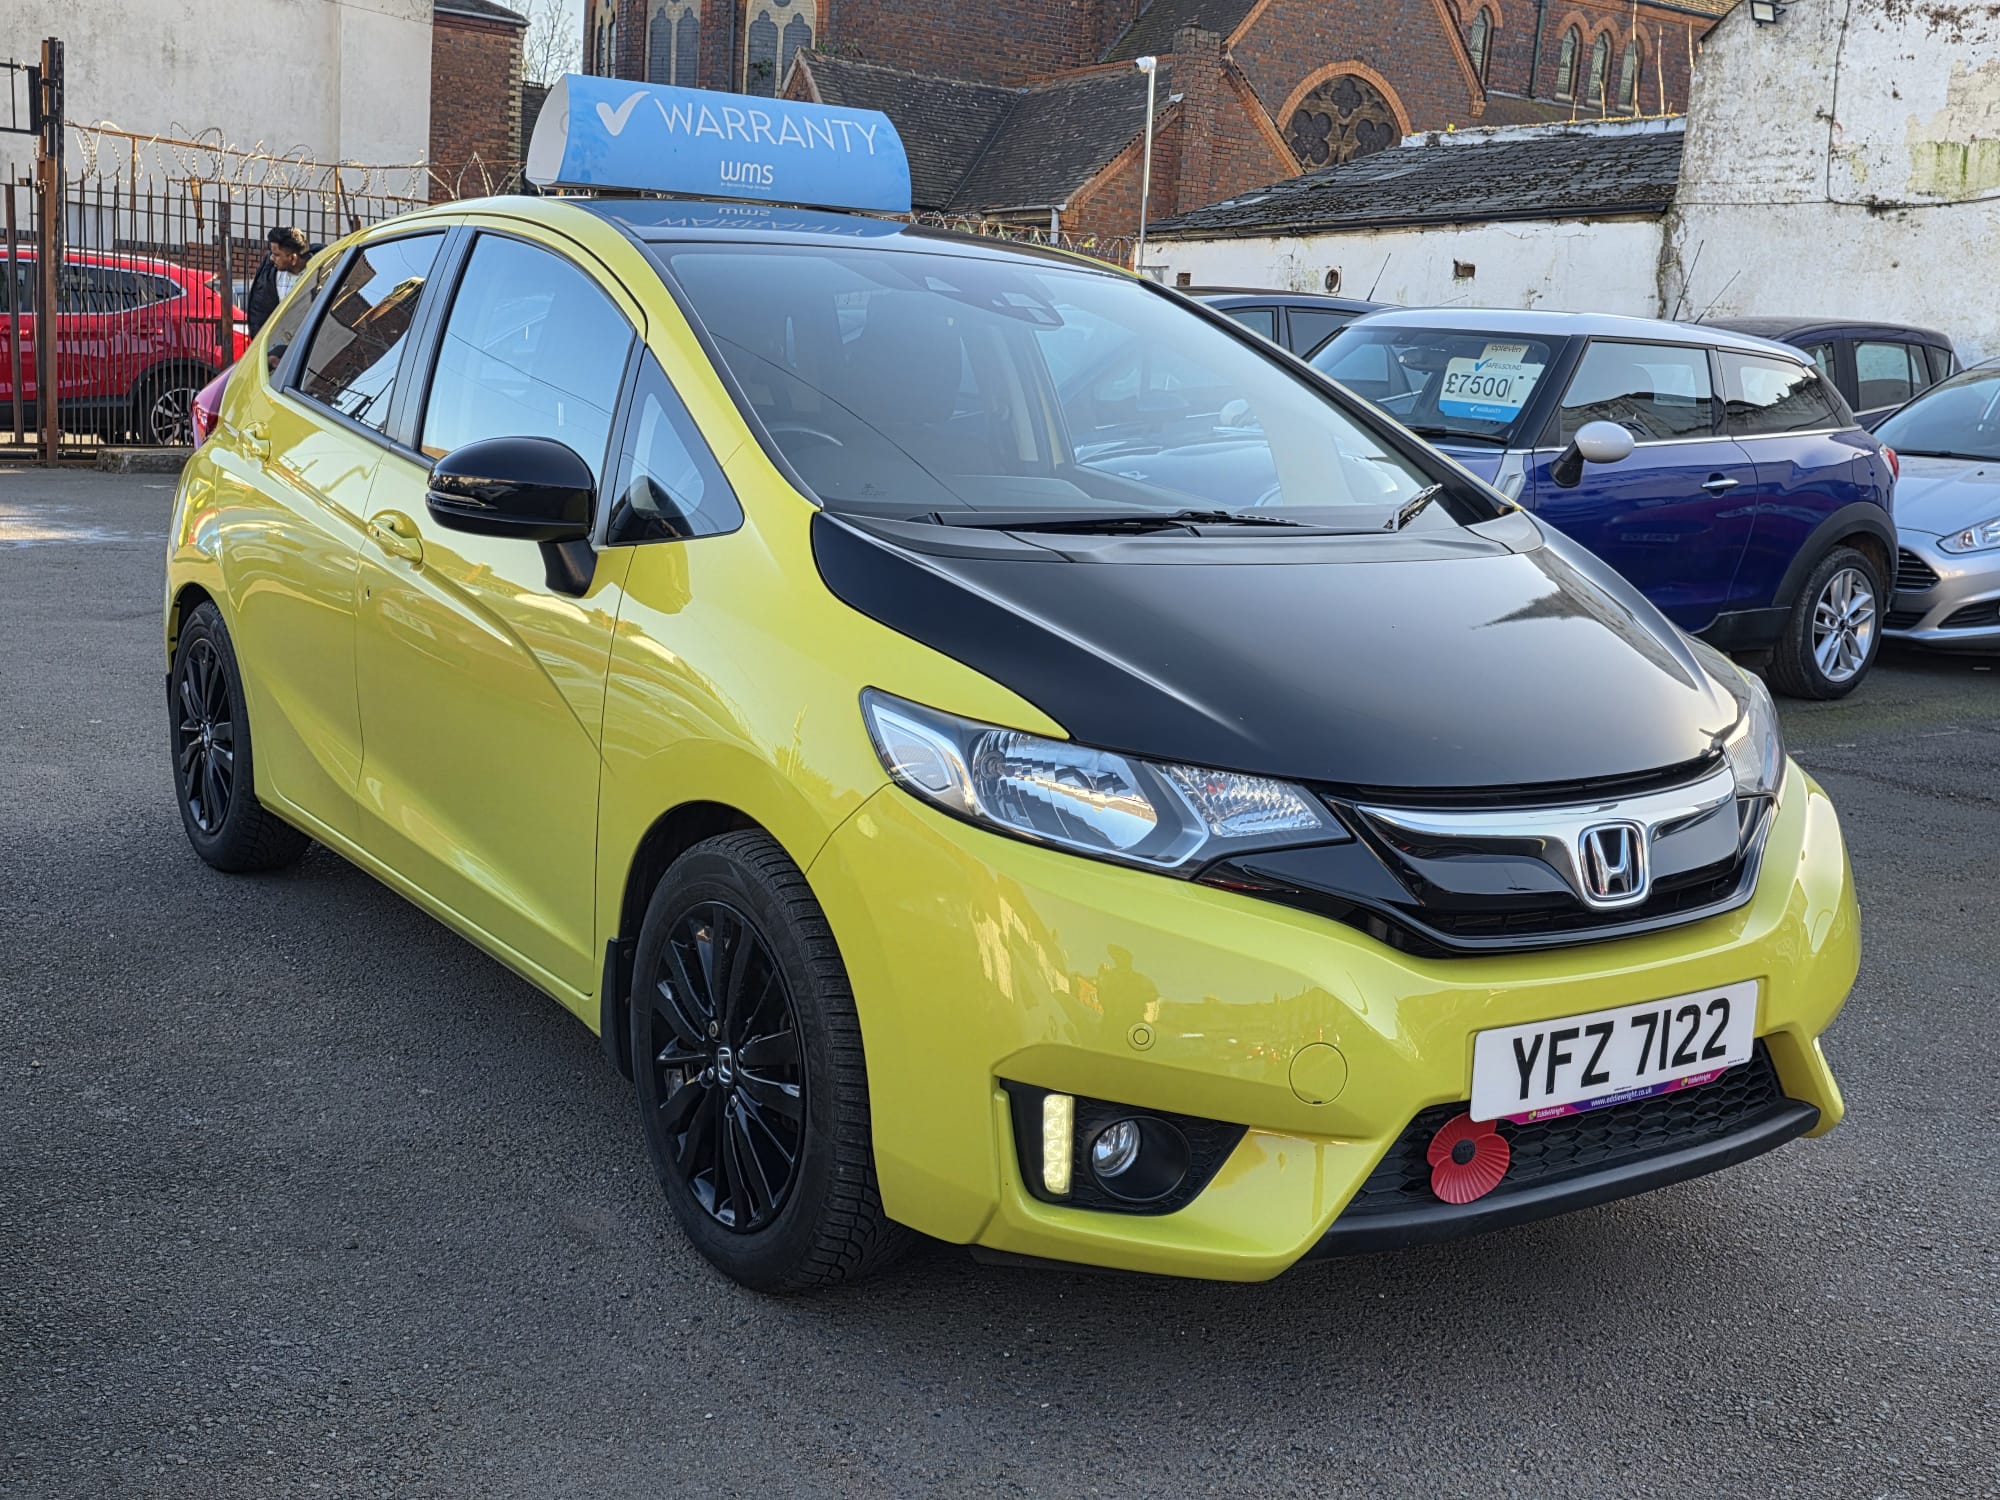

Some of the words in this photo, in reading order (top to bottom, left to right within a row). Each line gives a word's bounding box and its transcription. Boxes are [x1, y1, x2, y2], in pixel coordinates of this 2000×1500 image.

[654, 98, 878, 156] WARRANTY
[720, 160, 774, 185] wms
[1445, 373, 1509, 398] £7500
[1512, 1021, 1614, 1100] YFZ
[1631, 998, 1730, 1076] 7122
